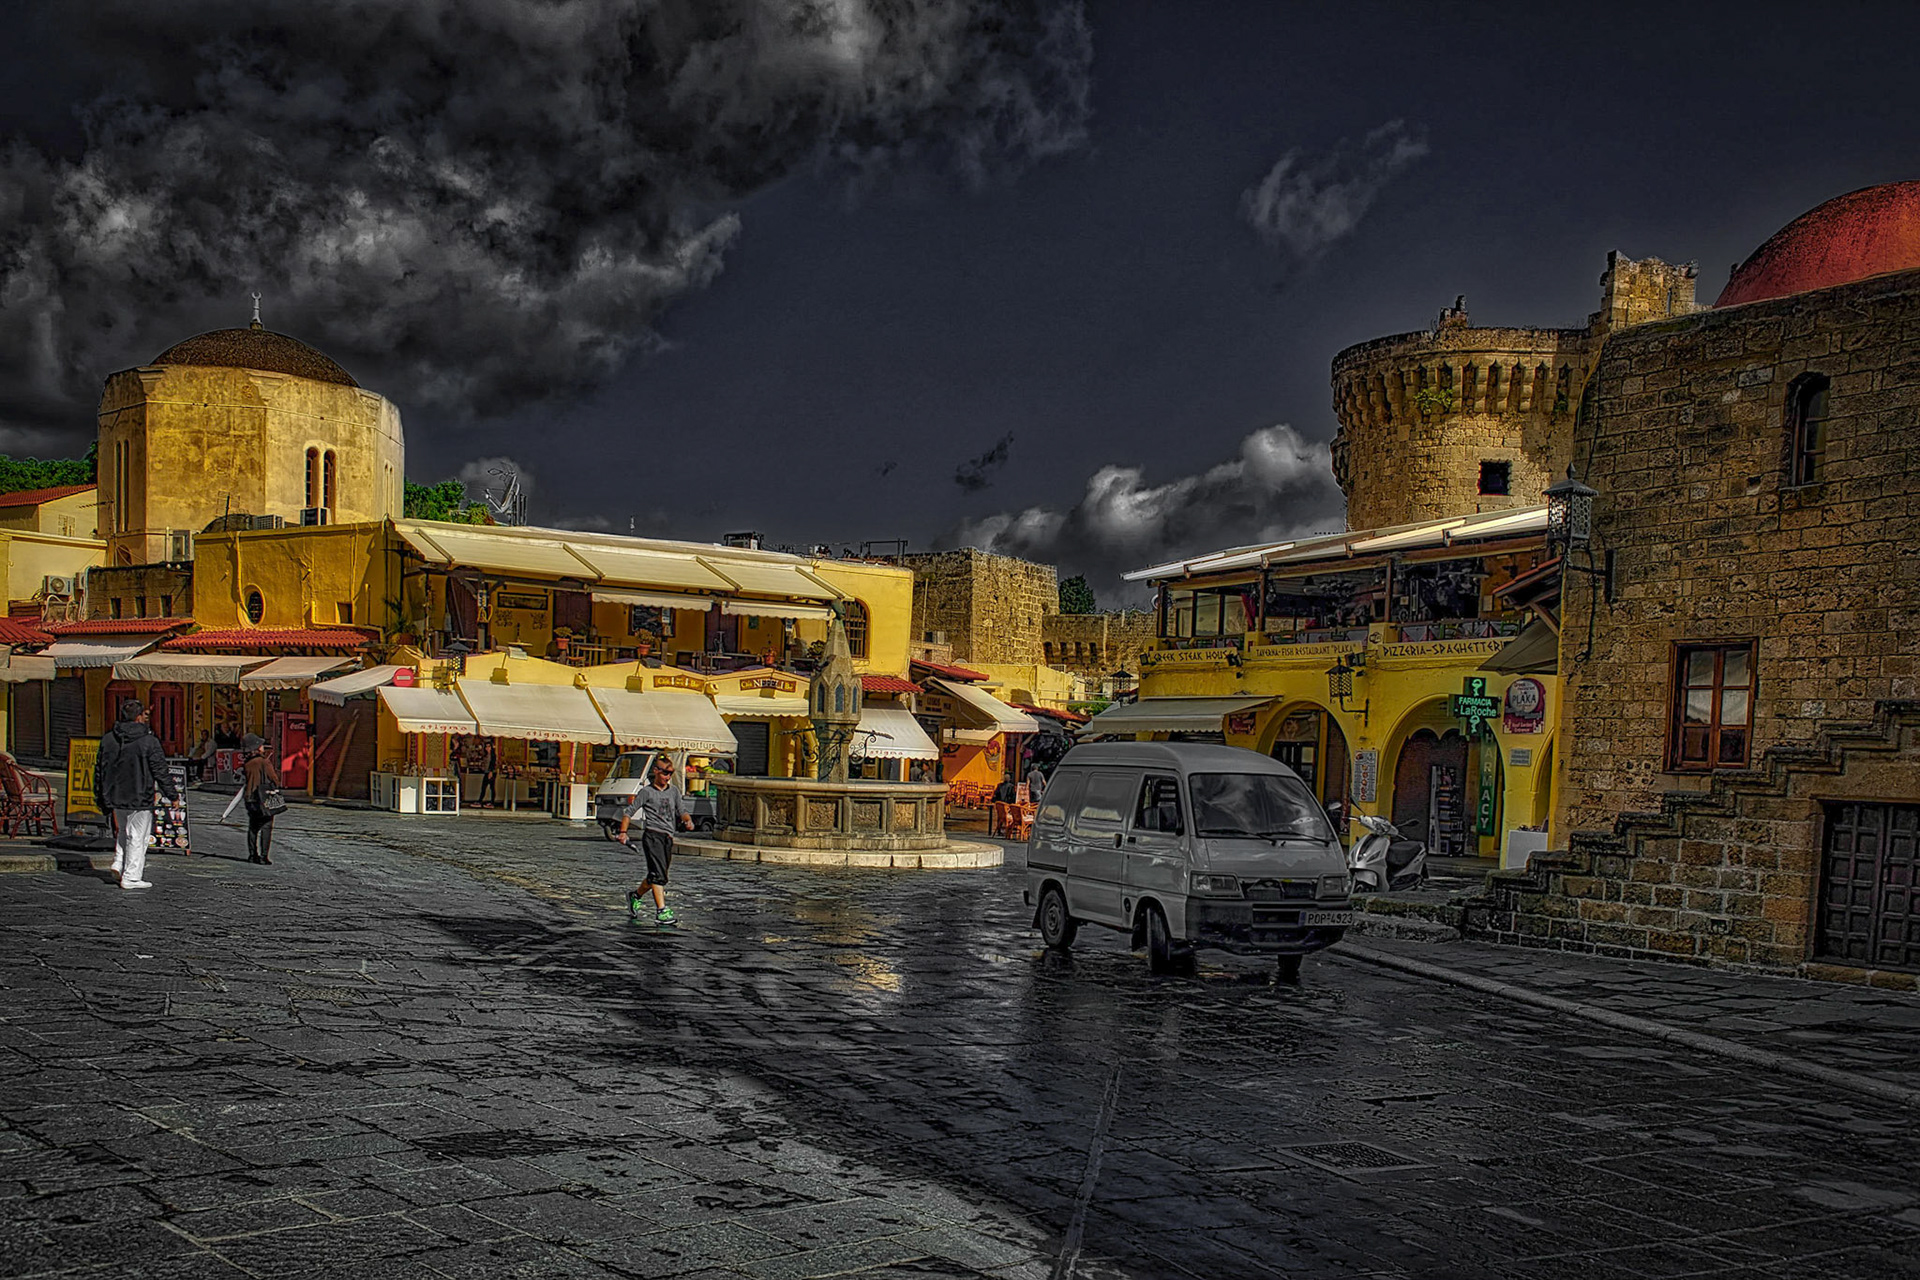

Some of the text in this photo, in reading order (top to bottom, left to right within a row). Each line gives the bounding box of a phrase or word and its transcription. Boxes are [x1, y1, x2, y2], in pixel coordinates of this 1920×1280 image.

[1296, 646, 1330, 656] RESTAURANT
[1382, 641, 1505, 657] PIZZERIA-SPAGHETTERI
[1153, 653, 1176, 662] GREEK
[1178, 652, 1202, 661] STEAK
[753, 678, 784, 690] NEFELI
[1458, 696, 1492, 707] FARMACIA
[1512, 694, 1537, 705] PLAKA
[1460, 705, 1497, 718] LaRoche
[420, 724, 467, 732] stigma
[526, 731, 568, 739] stigma
[630, 738, 669, 747] stigma
[870, 749, 903, 757] stigma
[73, 770, 91, 791] ΕΔ
[1481, 725, 1496, 829] HARMACY
